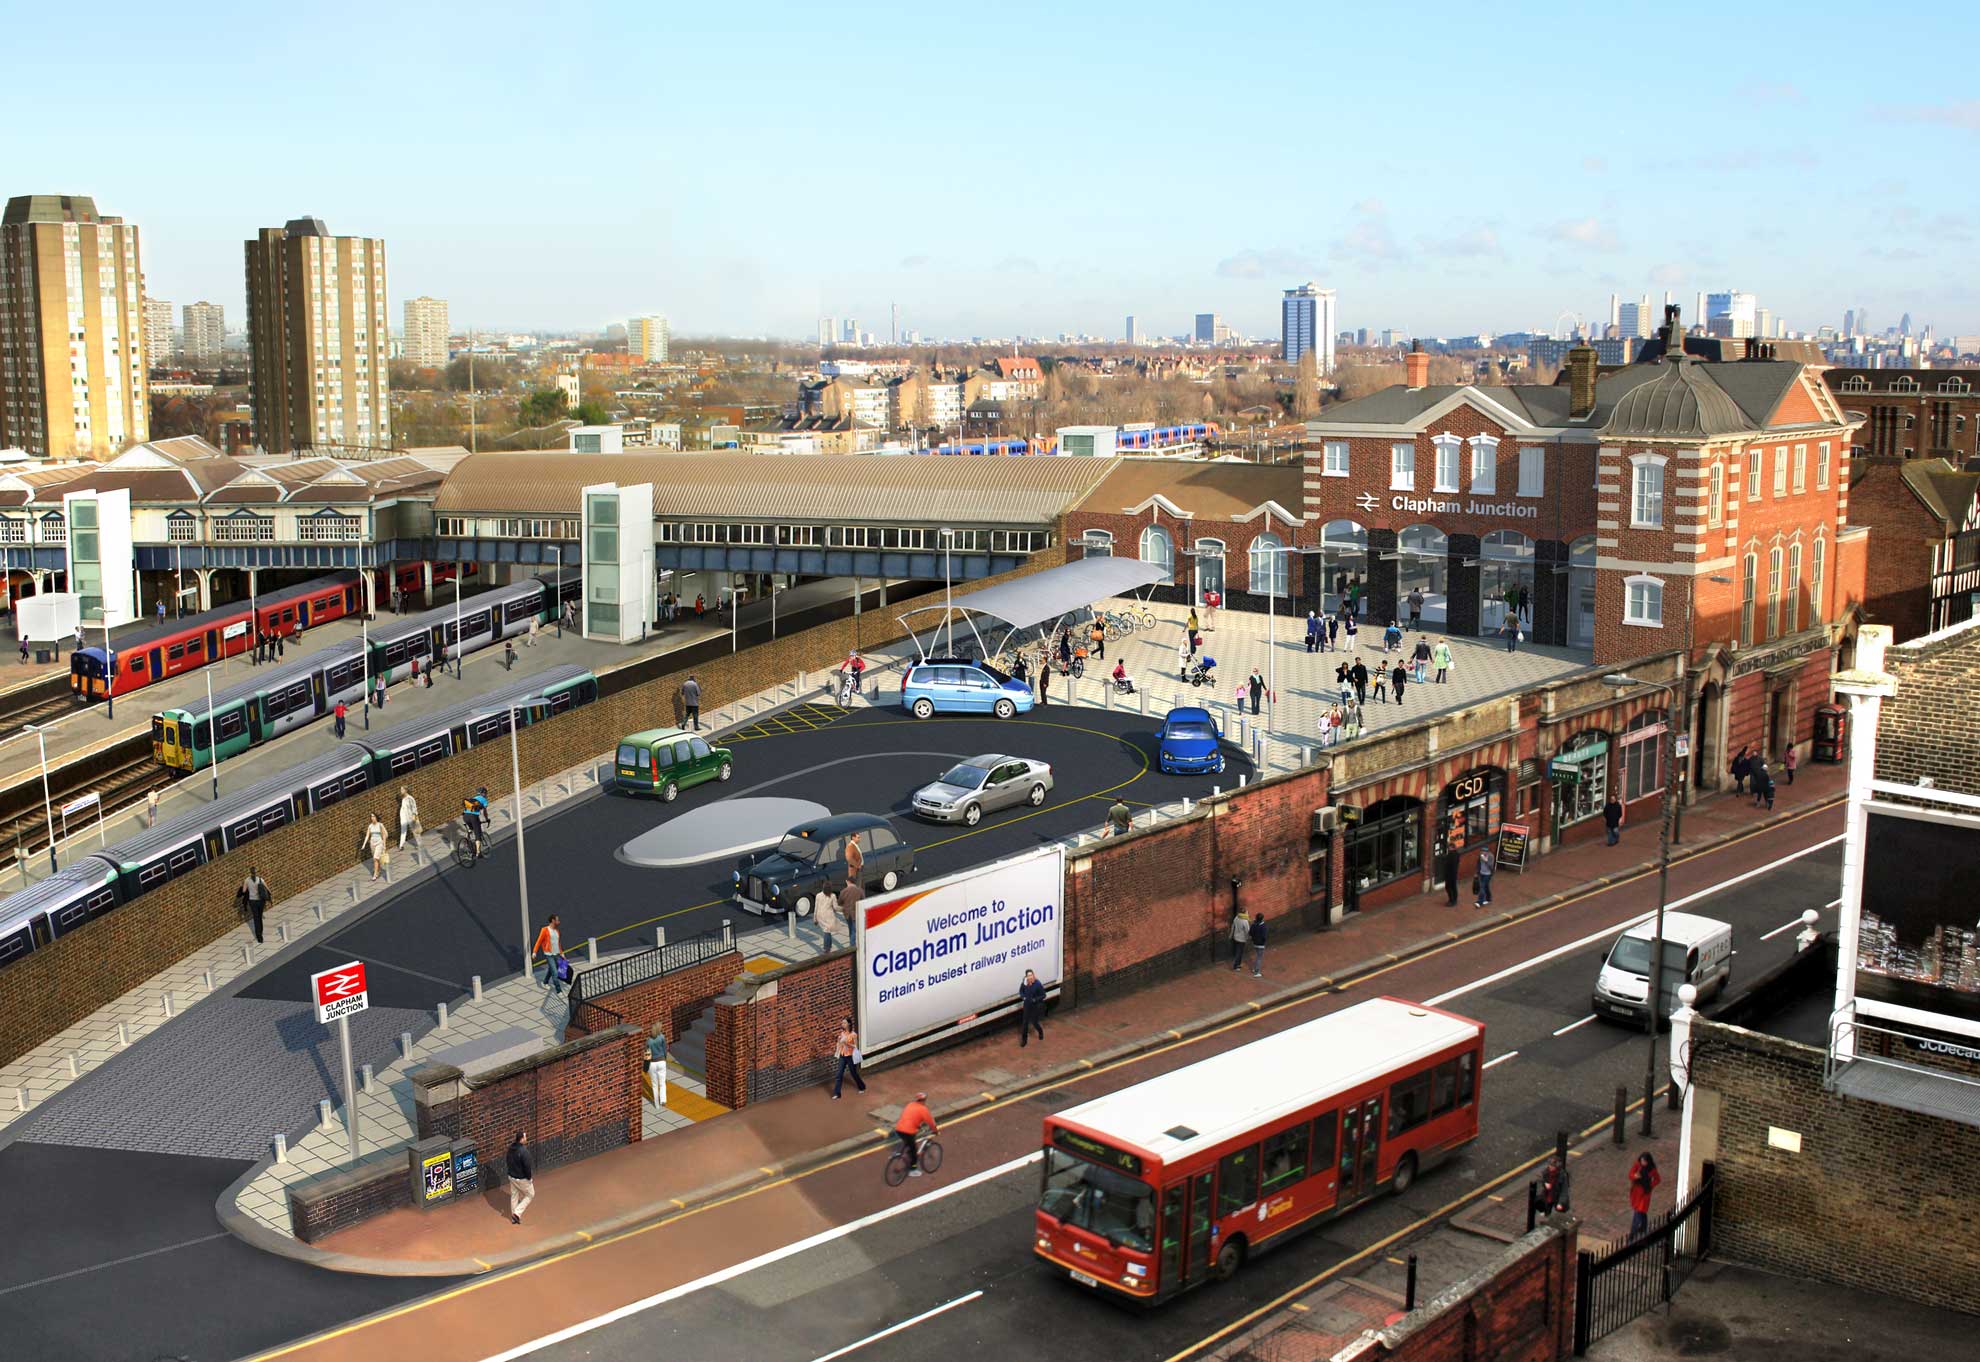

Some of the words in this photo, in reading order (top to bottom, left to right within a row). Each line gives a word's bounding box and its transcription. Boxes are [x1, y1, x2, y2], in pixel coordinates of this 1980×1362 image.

[1392, 496, 1460, 514] Clapham
[1466, 500, 1538, 517] Junction
[1455, 777, 1482, 800] CSD
[927, 904, 987, 934] Welcome
[992, 899, 1005, 914] to
[872, 932, 967, 977] Clapham
[974, 904, 1054, 946] Junction
[879, 978, 925, 1003] Britain's
[928, 964, 967, 986] busiest
[970, 950, 1008, 972] railway
[1010, 938, 1045, 959] station
[325, 994, 363, 1012] CLAPHAM
[326, 1001, 364, 1020] JUNCTION
